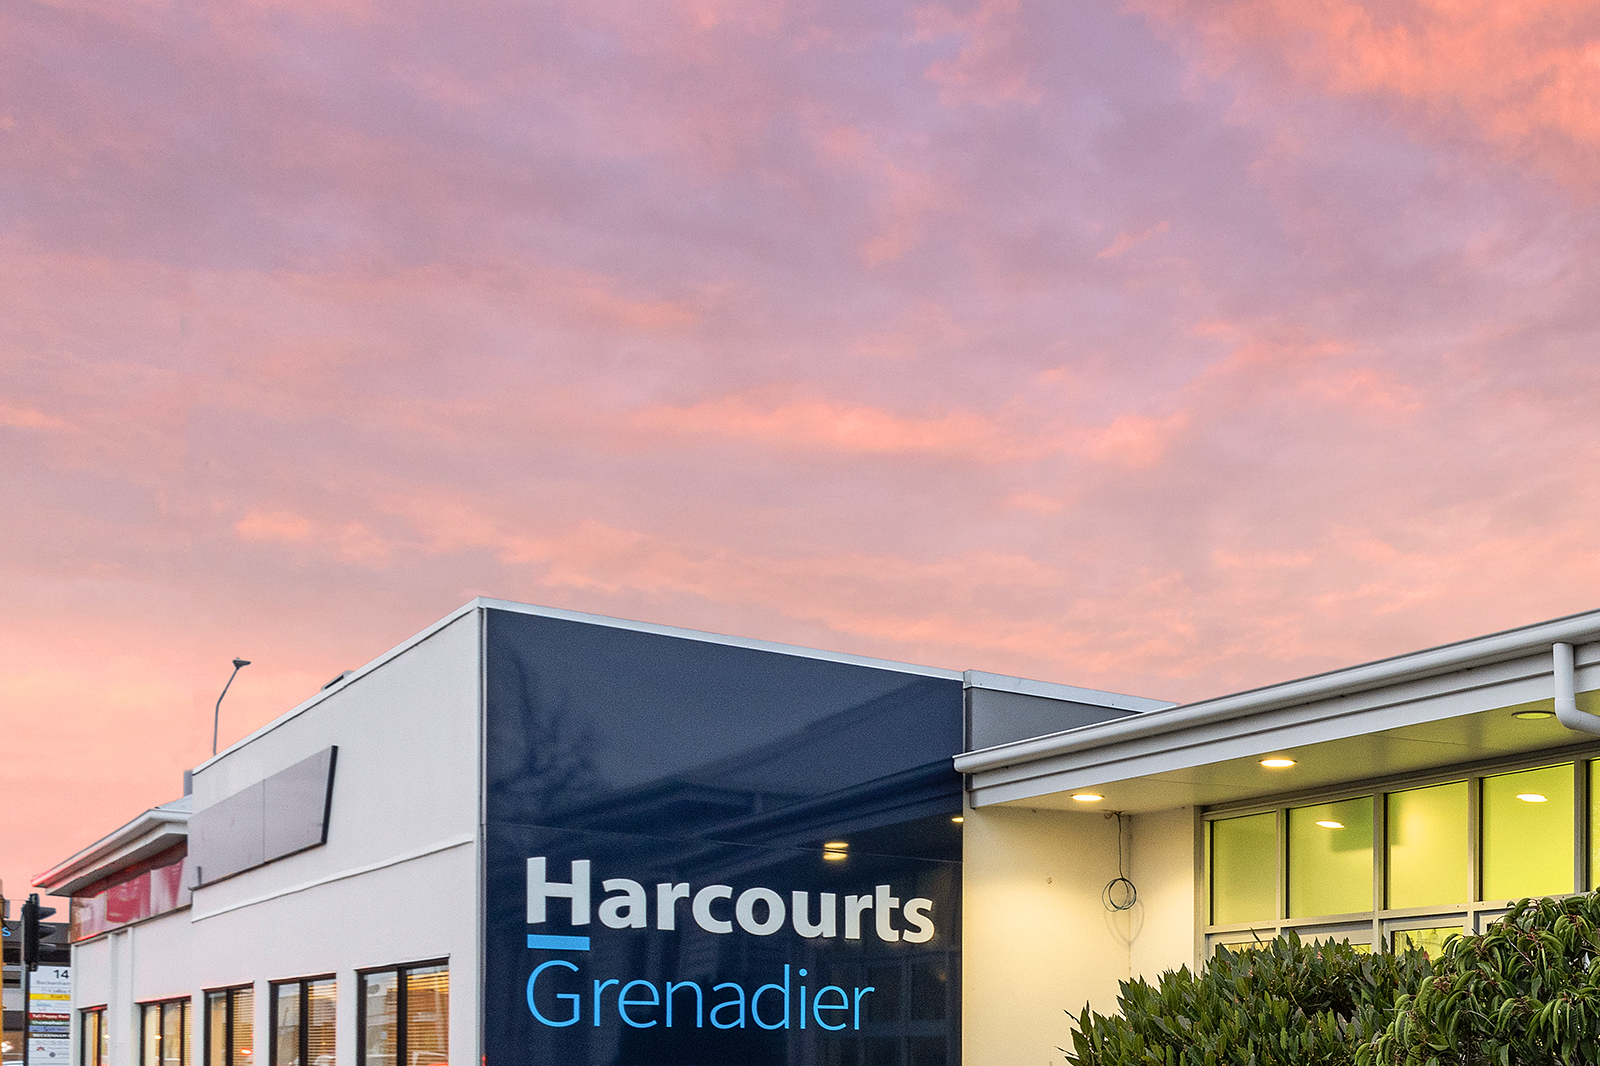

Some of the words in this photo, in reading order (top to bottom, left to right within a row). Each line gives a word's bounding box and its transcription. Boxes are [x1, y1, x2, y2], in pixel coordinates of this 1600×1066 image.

[526, 856, 935, 944] Harcourts
[54, 969, 70, 979] 14
[526, 960, 876, 1031] Grenadier
